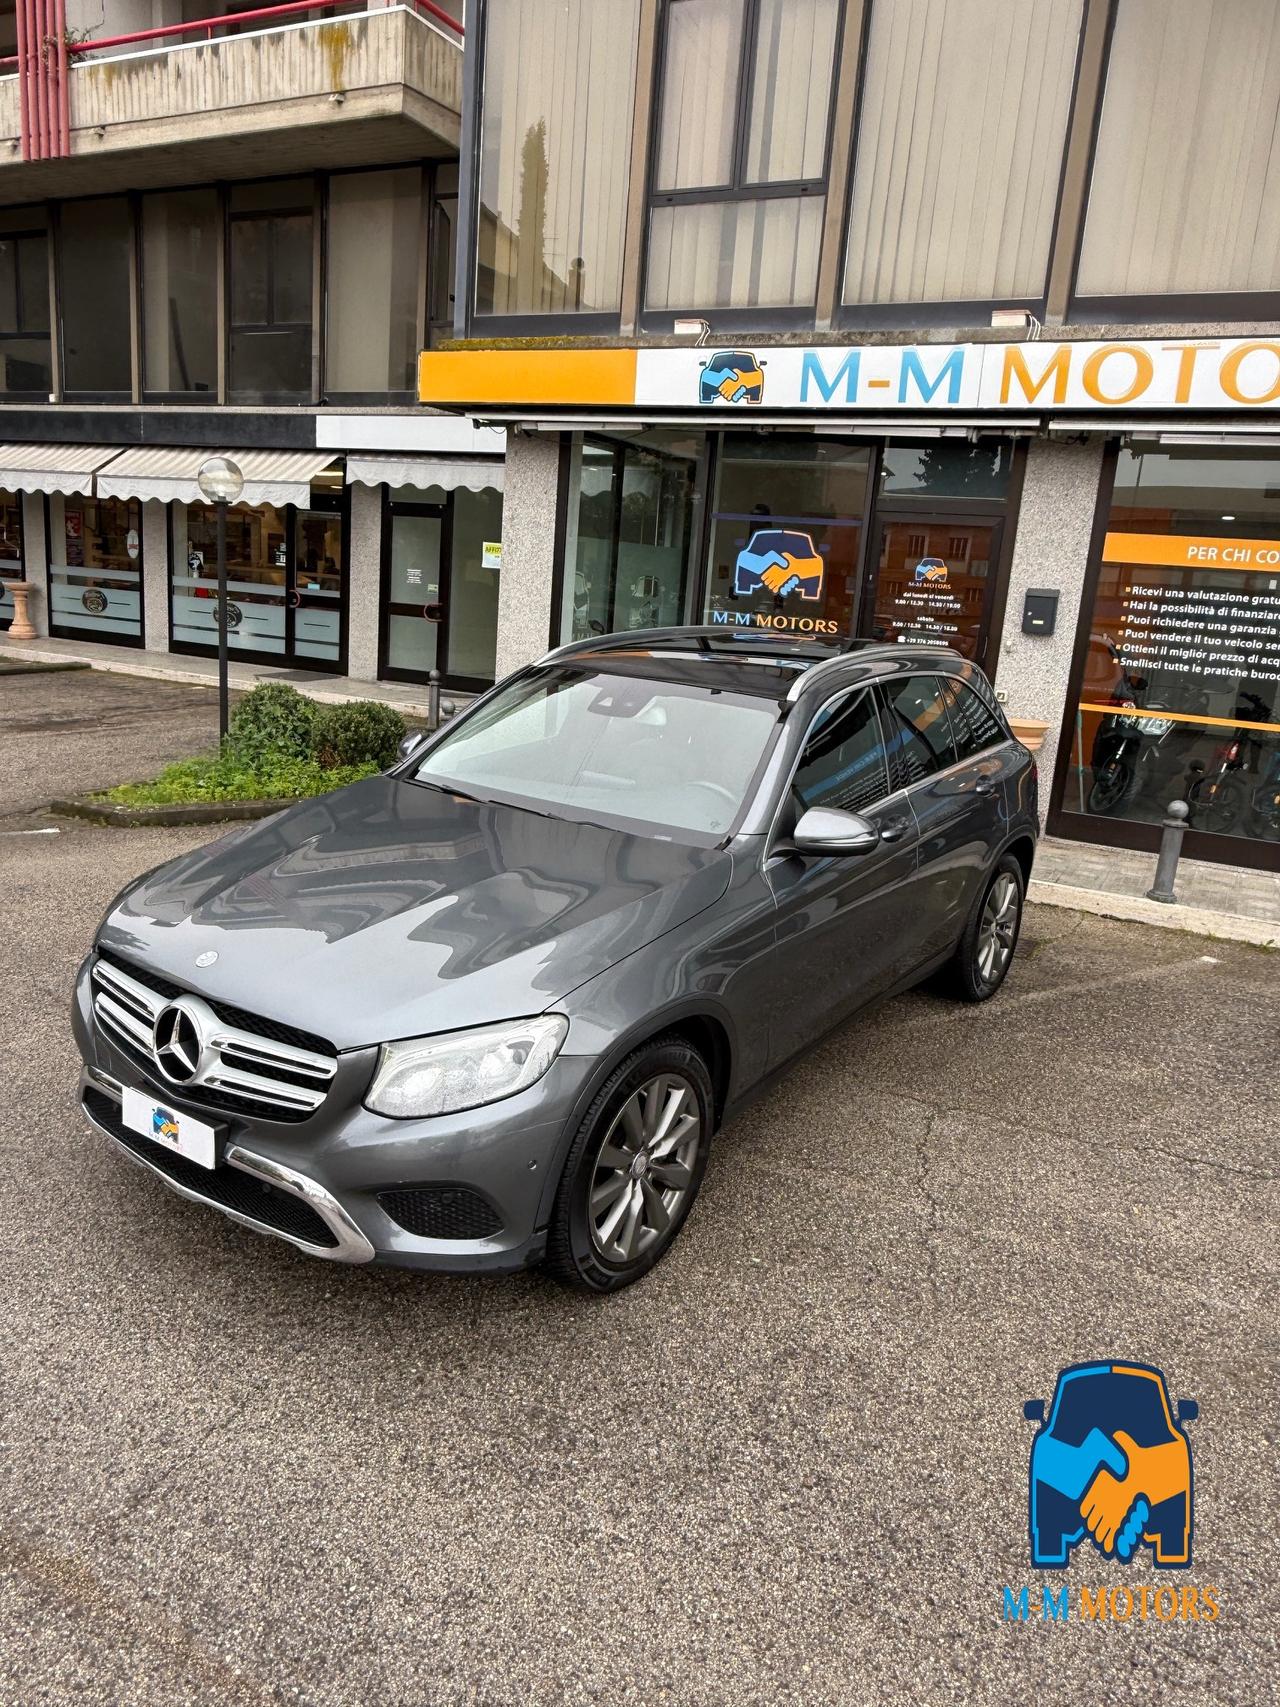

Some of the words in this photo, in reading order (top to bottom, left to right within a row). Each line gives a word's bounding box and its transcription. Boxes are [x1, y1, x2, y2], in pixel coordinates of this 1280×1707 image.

[800, 346, 964, 404] M-M
[1000, 341, 1280, 405] MOTO
[1187, 546, 1217, 560] PER
[1222, 548, 1251, 562] CHI
[1132, 586, 1162, 596] Ricevi
[1165, 589, 1184, 598] una
[1187, 590, 1249, 603] valutazione
[1130, 600, 1147, 610] Hai
[1149, 602, 1158, 611] la
[1160, 603, 1214, 615] possibilità
[1218, 607, 1228, 616] di
[713, 611, 750, 625] M-M
[756, 614, 838, 633] MOTORS
[1127, 615, 1150, 625] Puoi
[1152, 616, 1204, 629] richiedere
[1208, 620, 1227, 631] una
[1230, 621, 1276, 635] garanzia
[1125, 629, 1147, 639] Puoi
[1150, 631, 1192, 643] vendere
[1194, 634, 1201, 643] il
[1204, 636, 1222, 645] tuo
[1224, 638, 1263, 649] veicolo
[1122, 643, 1158, 654] Ottieni
[1160, 646, 1167, 655] il
[1170, 647, 1207, 659] miglior
[1209, 651, 1245, 662] prezzo
[1248, 653, 1259, 663] di
[1120, 657, 1161, 669] Snellisci
[1164, 661, 1189, 672] tutte
[1192, 663, 1201, 673] le
[1204, 665, 1248, 678] pratiche
